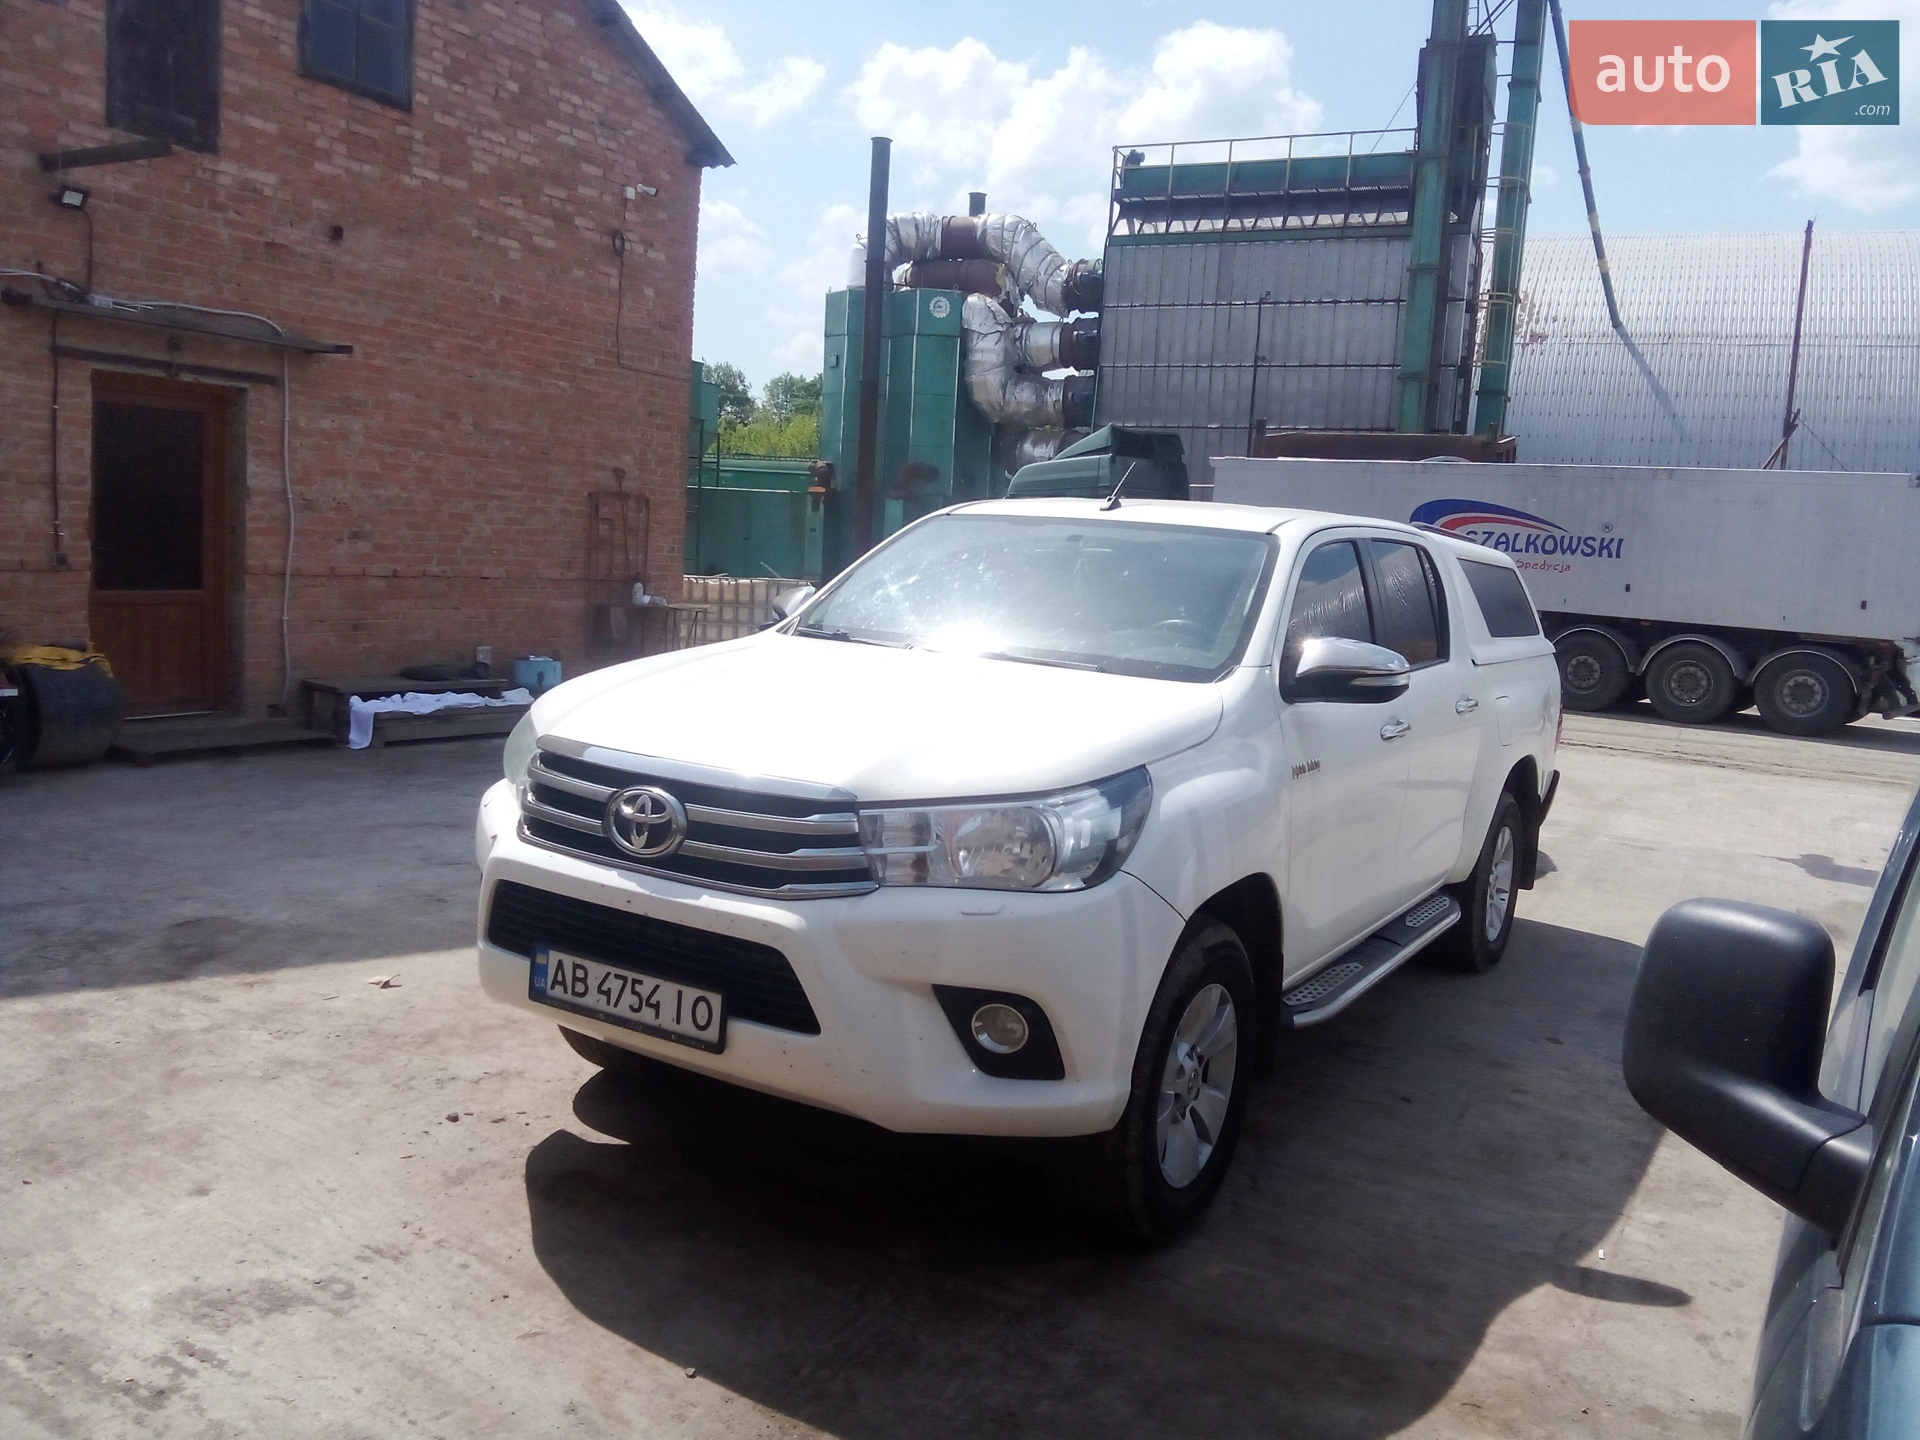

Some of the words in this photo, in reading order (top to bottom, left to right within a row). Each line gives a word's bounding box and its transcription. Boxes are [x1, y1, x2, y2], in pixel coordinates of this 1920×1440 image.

[534, 976, 546, 989] UA
[550, 959, 589, 999] AB
[596, 972, 662, 1020] 4754
[675, 990, 713, 1031] IO
